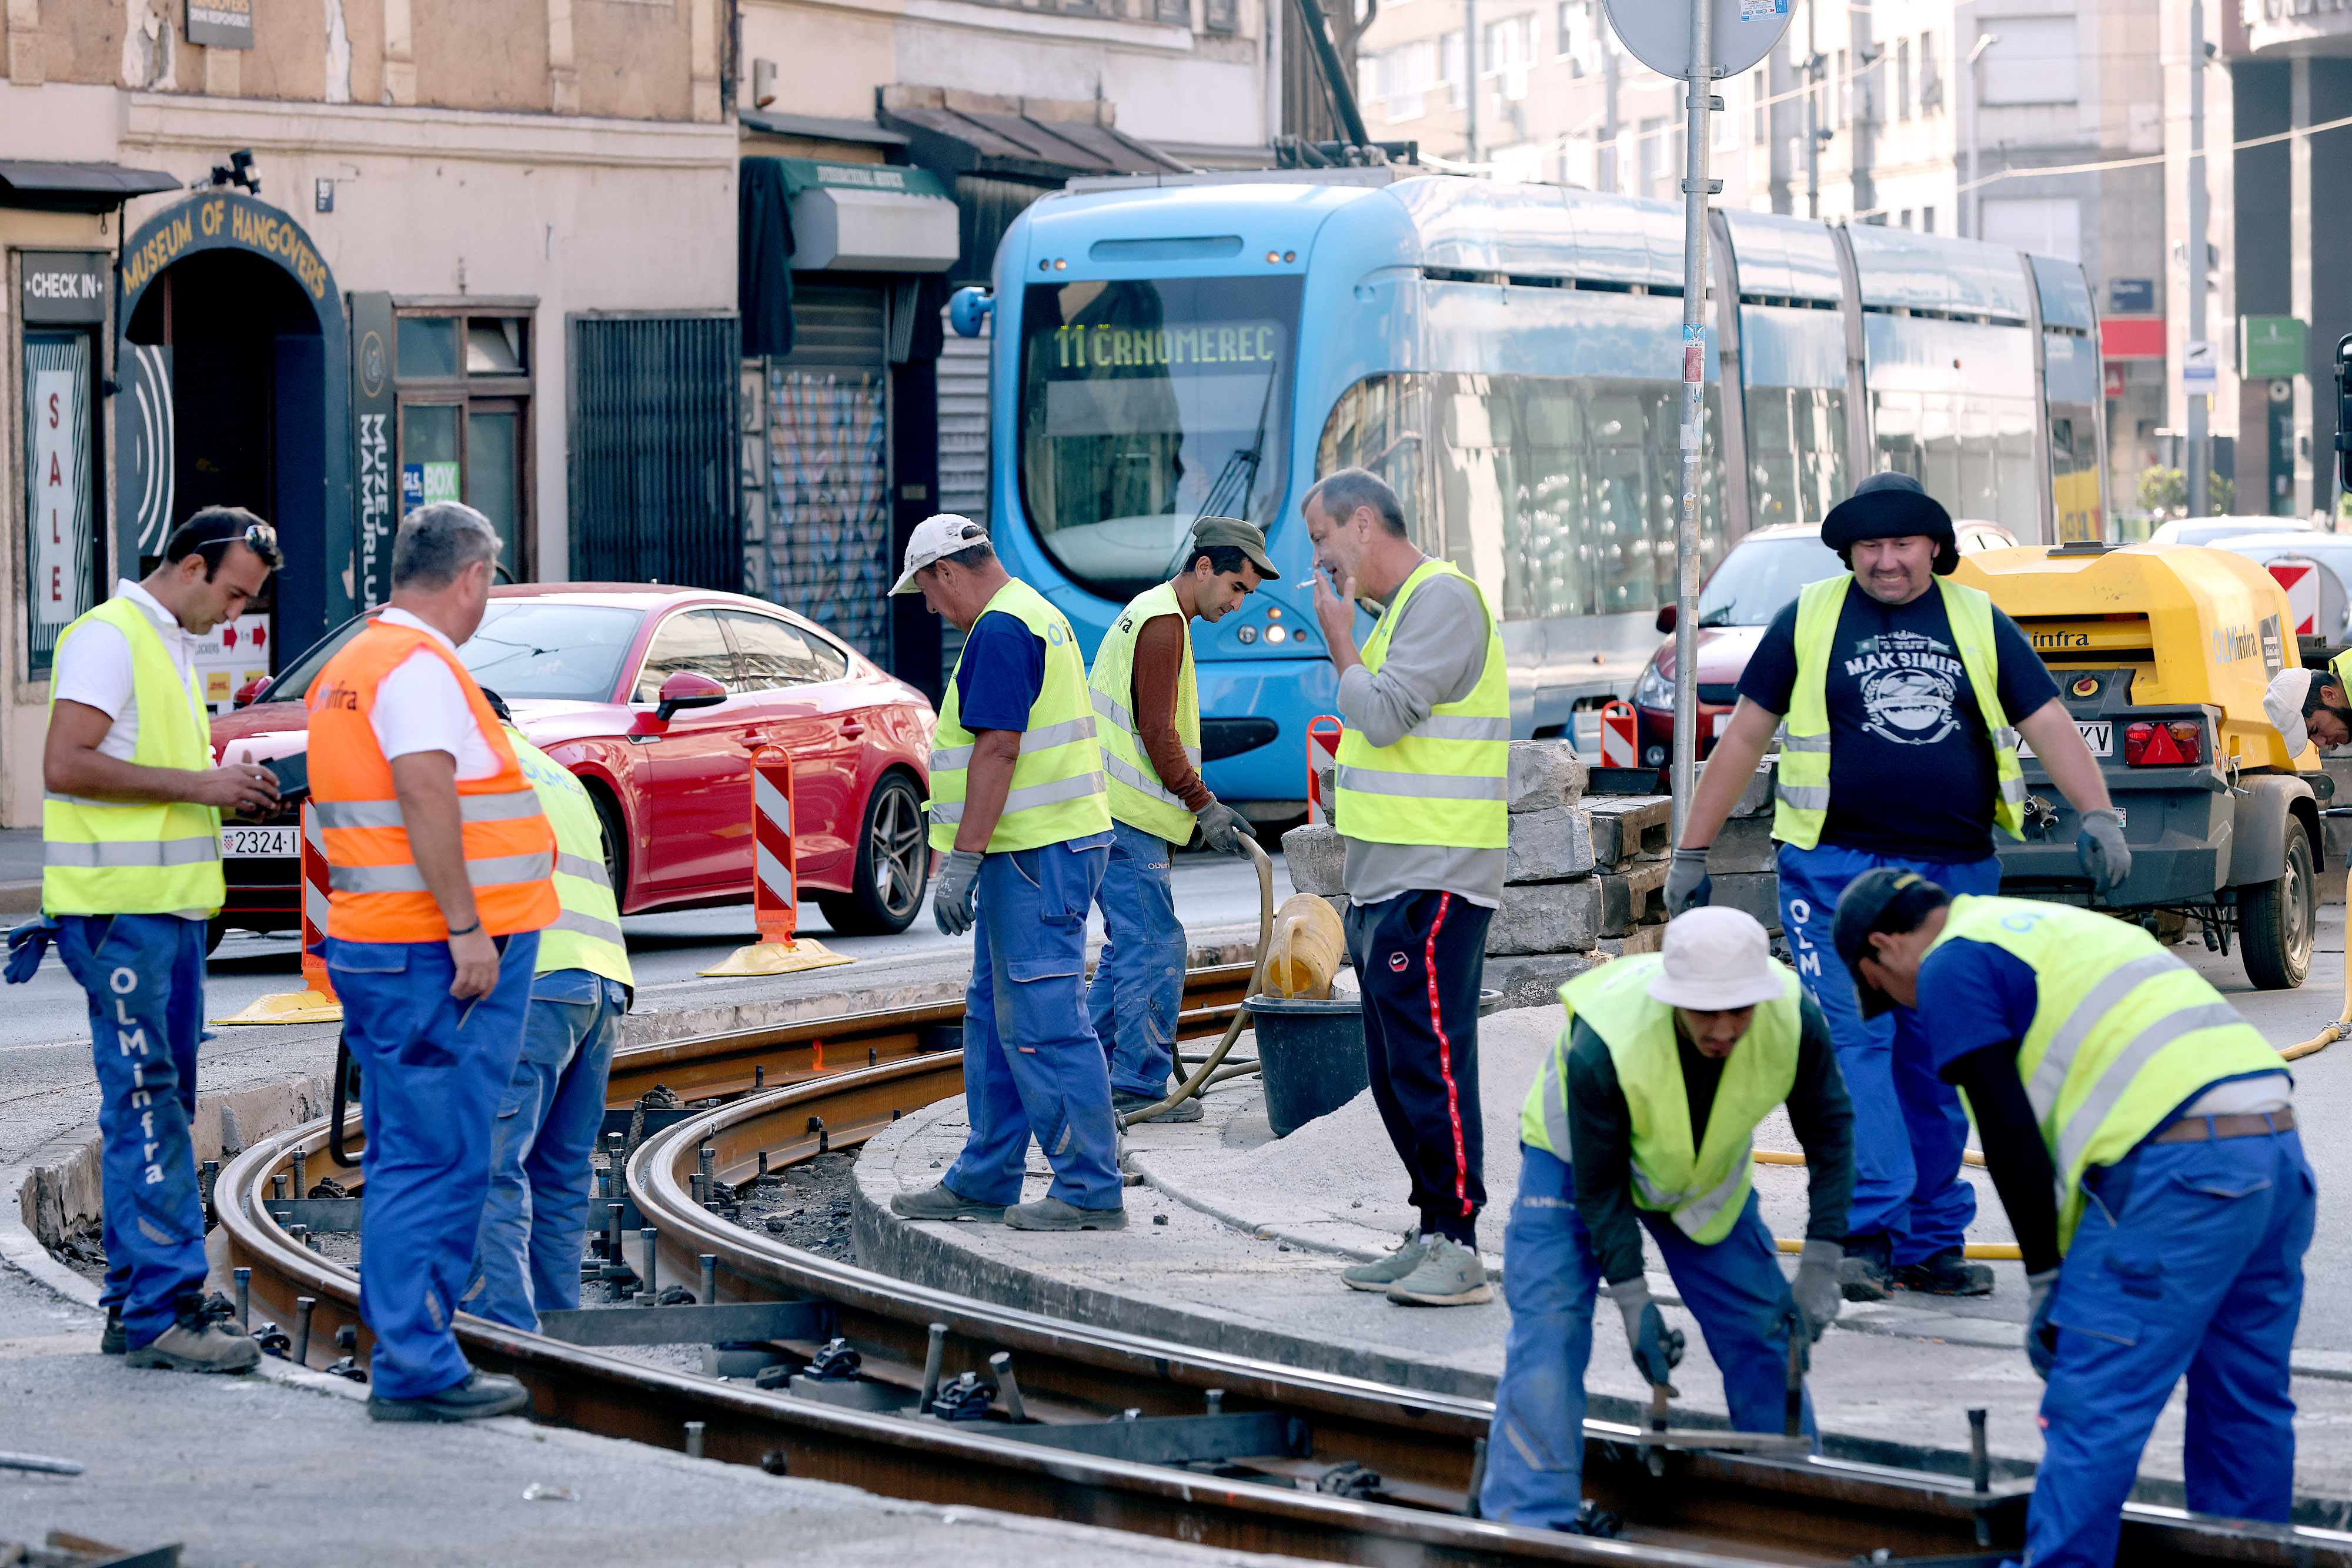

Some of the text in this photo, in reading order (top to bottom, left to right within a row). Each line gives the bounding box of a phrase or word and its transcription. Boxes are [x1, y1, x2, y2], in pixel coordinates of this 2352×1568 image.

[122, 200, 327, 299] MUSEUM OF HANGOVERS
[32, 272, 96, 299] CHECK IN
[1054, 325, 1085, 367] 11
[373, 413, 389, 536] MUZEJ
[424, 466, 455, 496] BOX
[49, 392, 62, 601] SALE
[2024, 631, 2089, 647] infra
[2213, 624, 2257, 665] OLMinfra
[1844, 651, 1963, 677] MAKSIMIR
[109, 967, 165, 1185] OLMinfra
